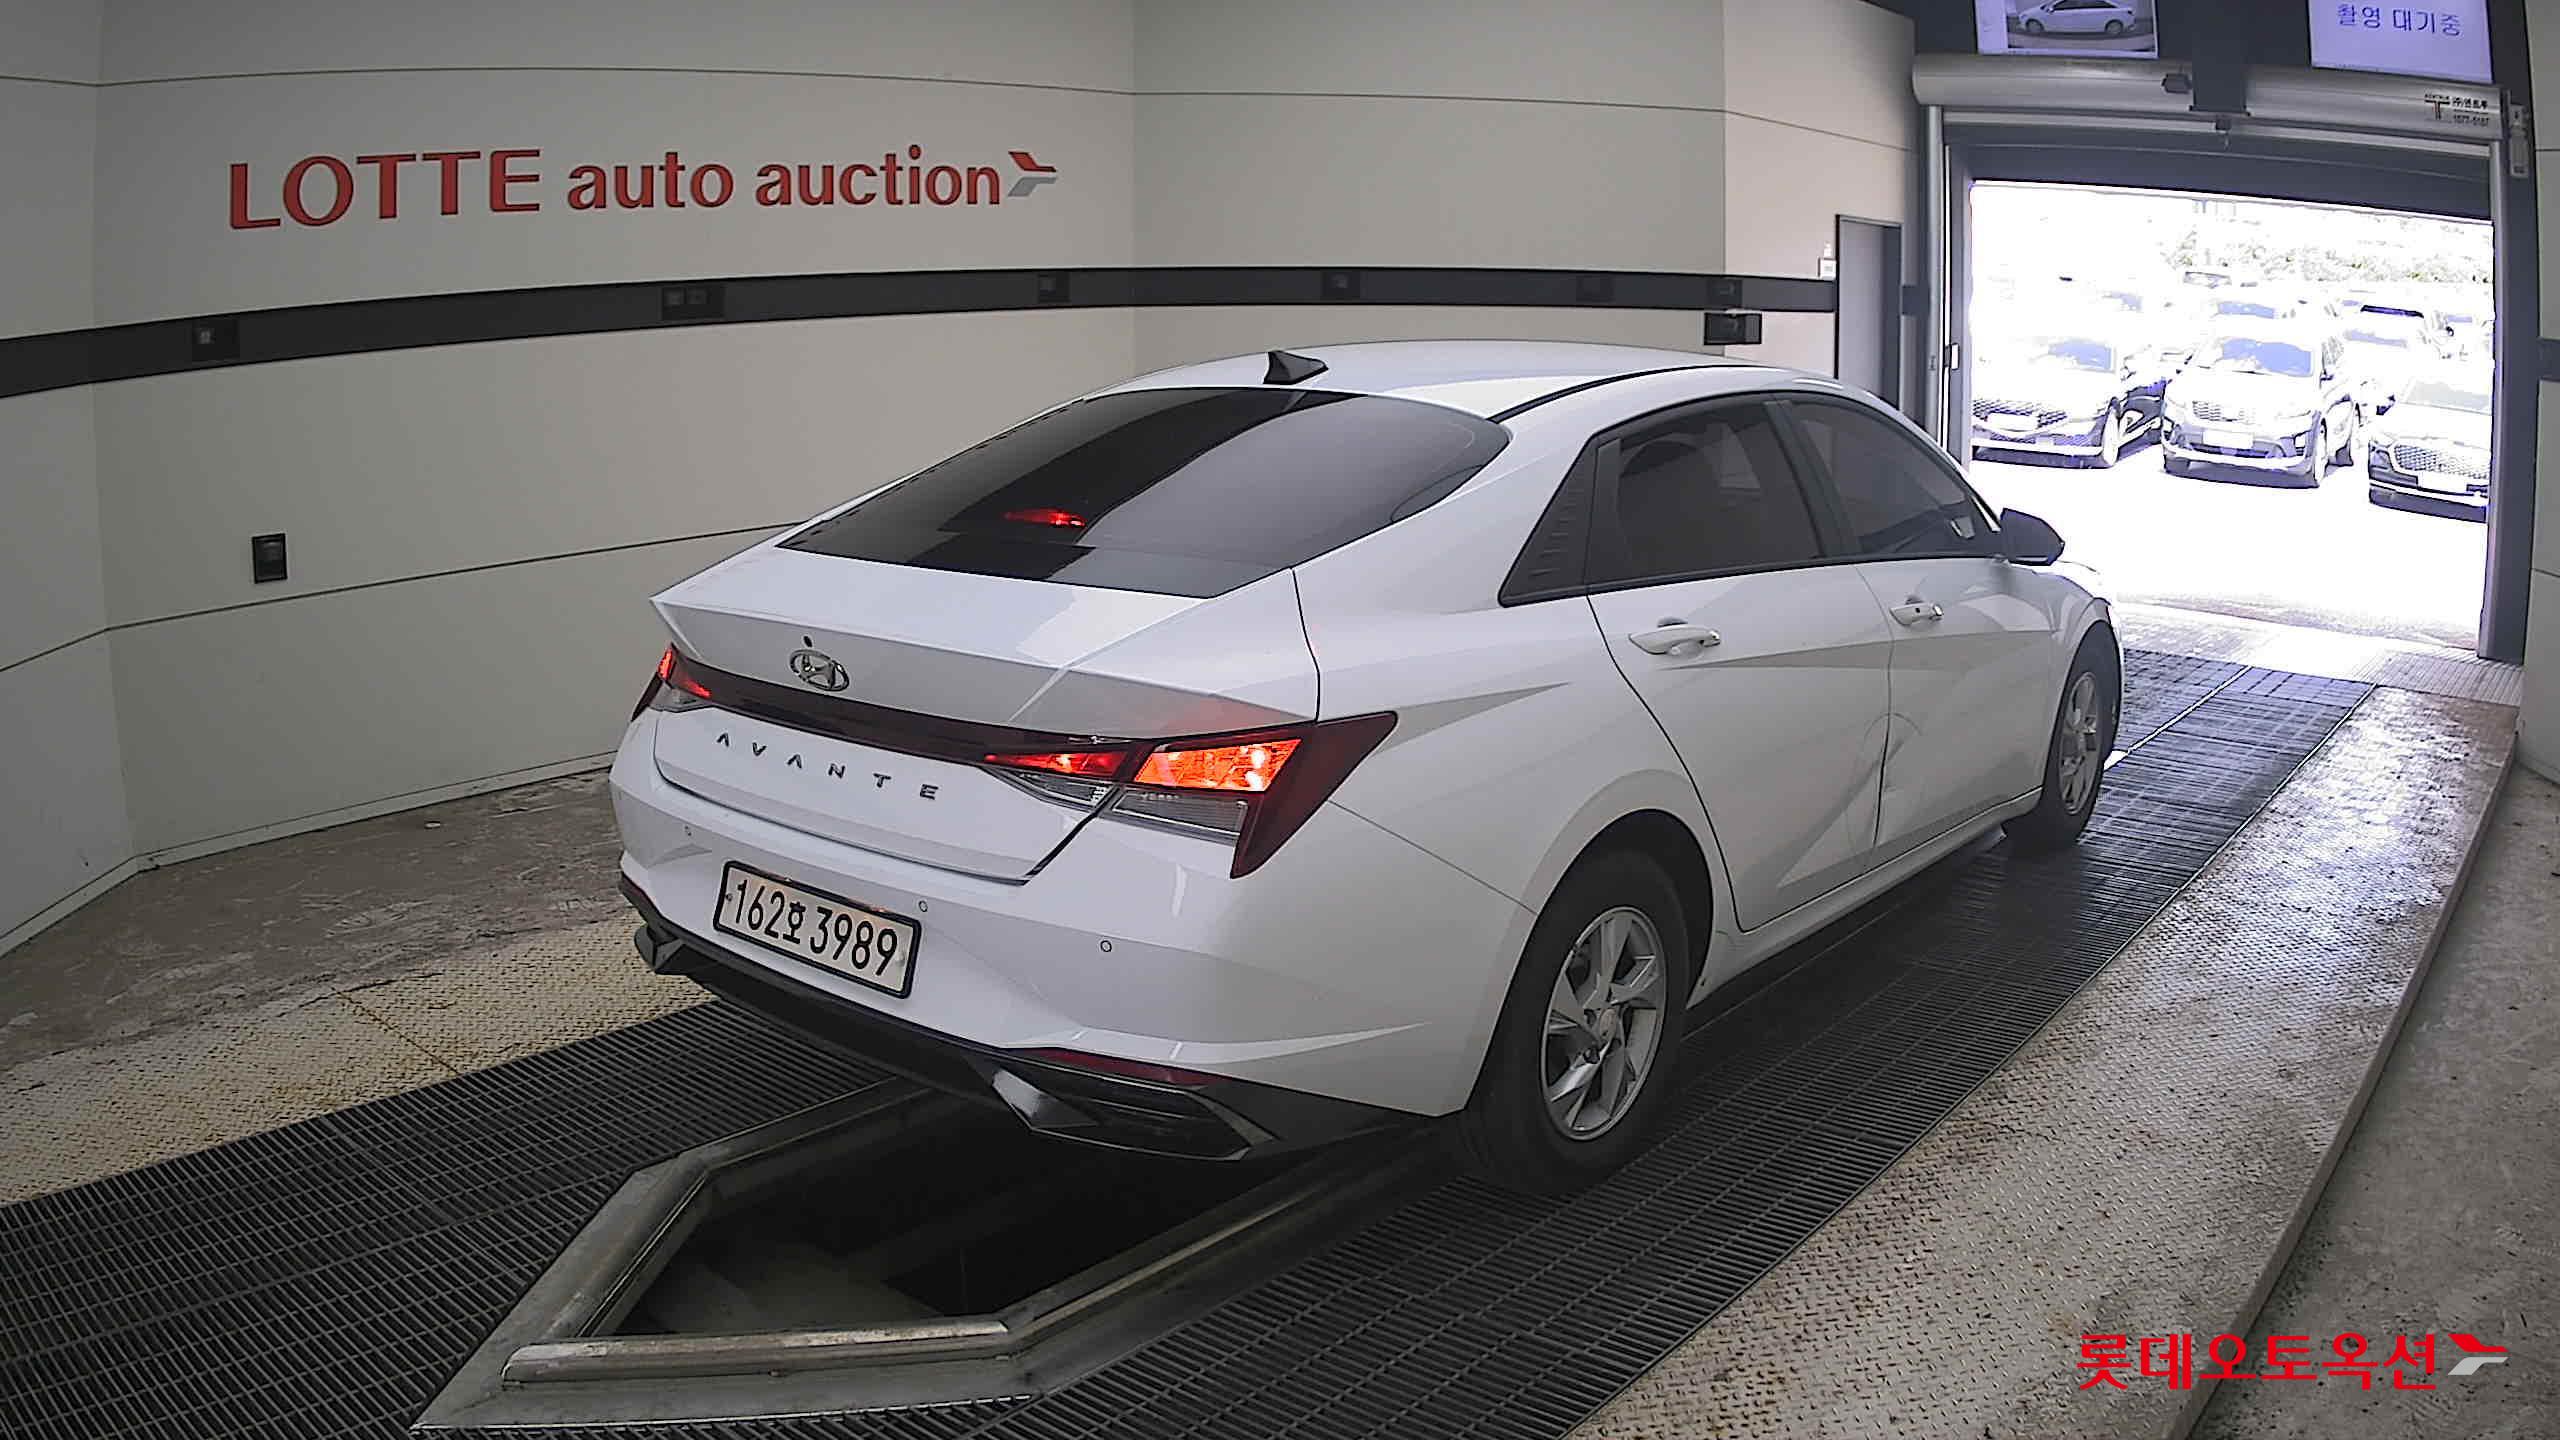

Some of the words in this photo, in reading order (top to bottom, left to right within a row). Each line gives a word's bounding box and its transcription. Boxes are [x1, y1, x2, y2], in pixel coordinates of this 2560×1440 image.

[2337, 3, 2382, 30] 촬영
[2392, 8, 2462, 37] 대기중
[229, 149, 541, 230] LOTTE
[566, 152, 735, 211] auto
[755, 144, 1002, 207] auction
[716, 732, 940, 800] AVANTE
[809, 905, 899, 976] 3989
